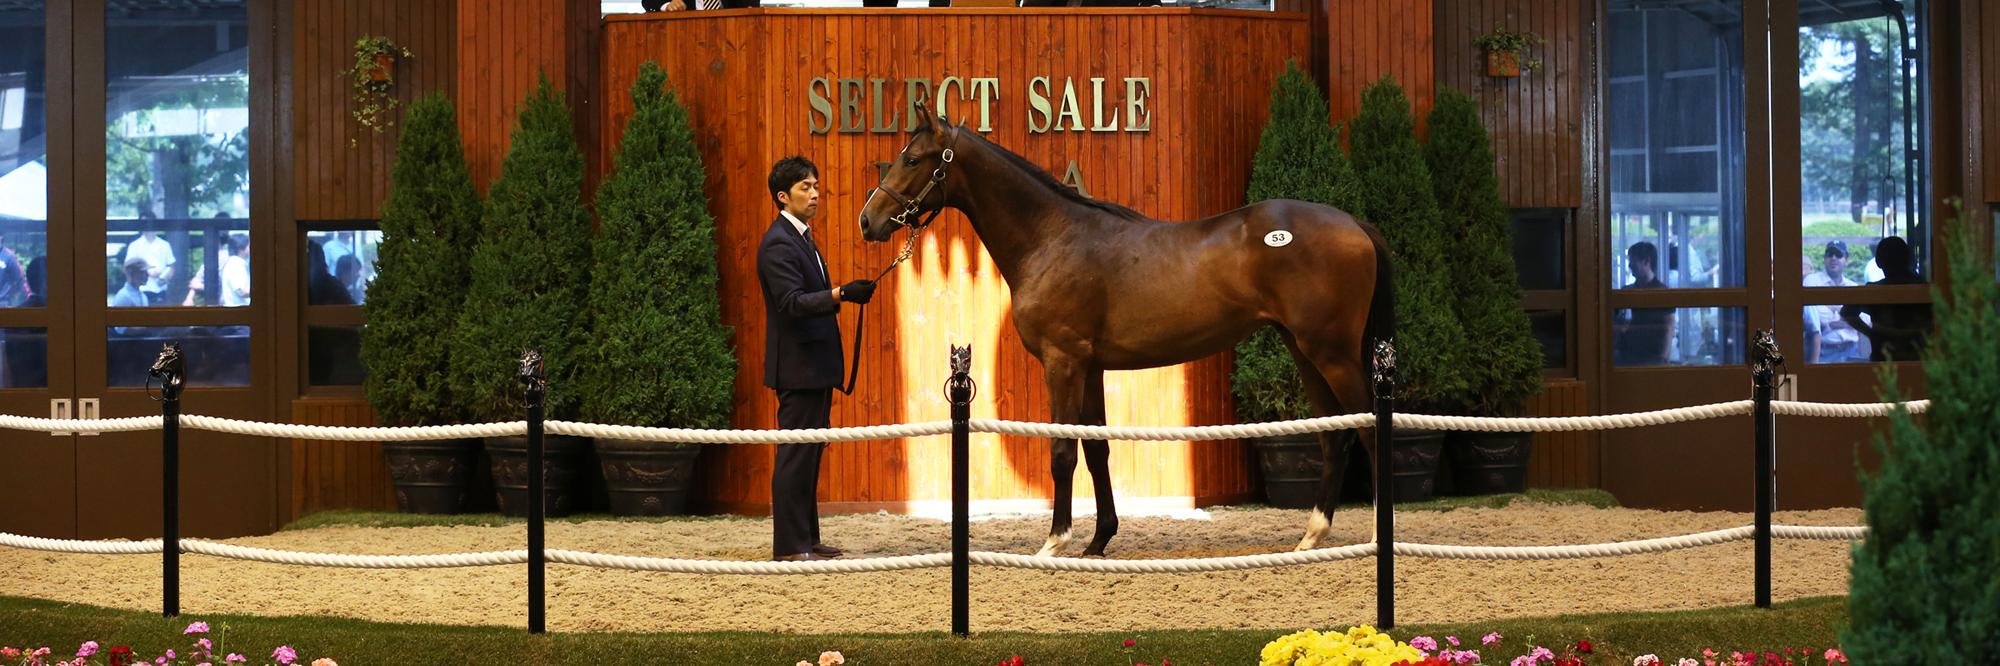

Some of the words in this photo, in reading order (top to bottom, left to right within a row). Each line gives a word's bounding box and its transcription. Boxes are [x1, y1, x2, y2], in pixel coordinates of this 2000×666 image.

[808, 76, 999, 134] SELECT
[1029, 75, 1151, 134] SALE
[1272, 233, 1285, 242] 53
